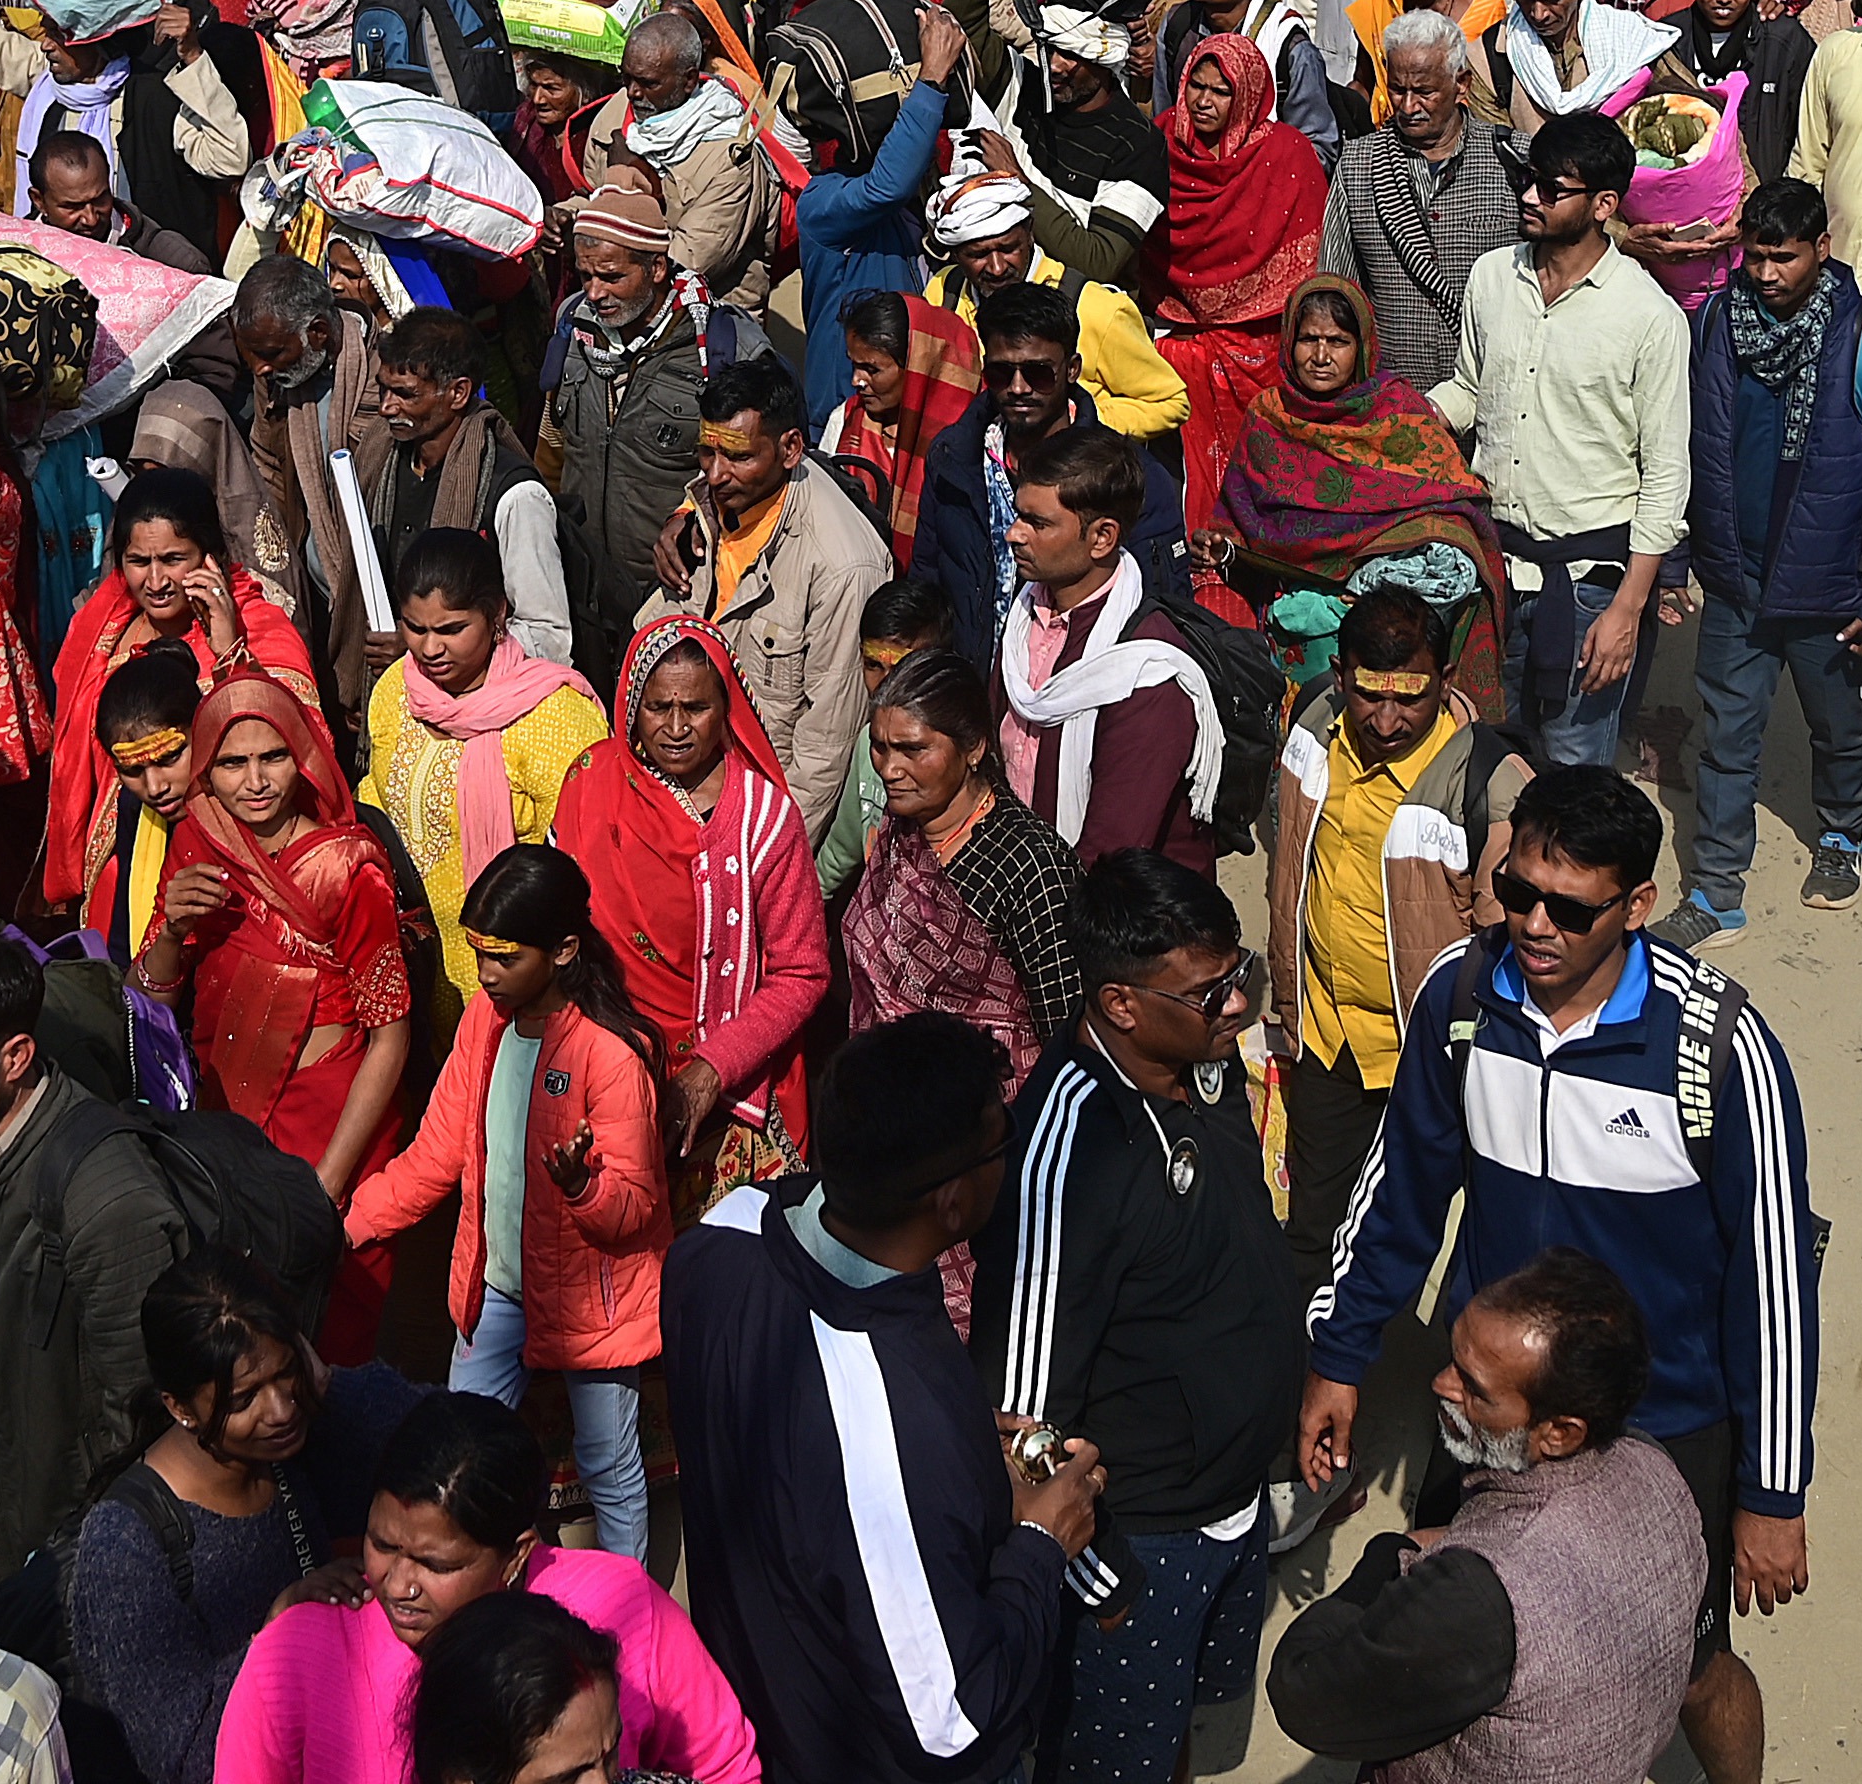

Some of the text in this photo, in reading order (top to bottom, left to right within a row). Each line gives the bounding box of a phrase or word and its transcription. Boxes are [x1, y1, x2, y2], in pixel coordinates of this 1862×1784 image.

[1682, 989, 1720, 1036] IN
[1677, 1034, 1714, 1138] MOVE
[1605, 1123, 1651, 1138] adidas
[287, 1506, 316, 1577] OREVER
